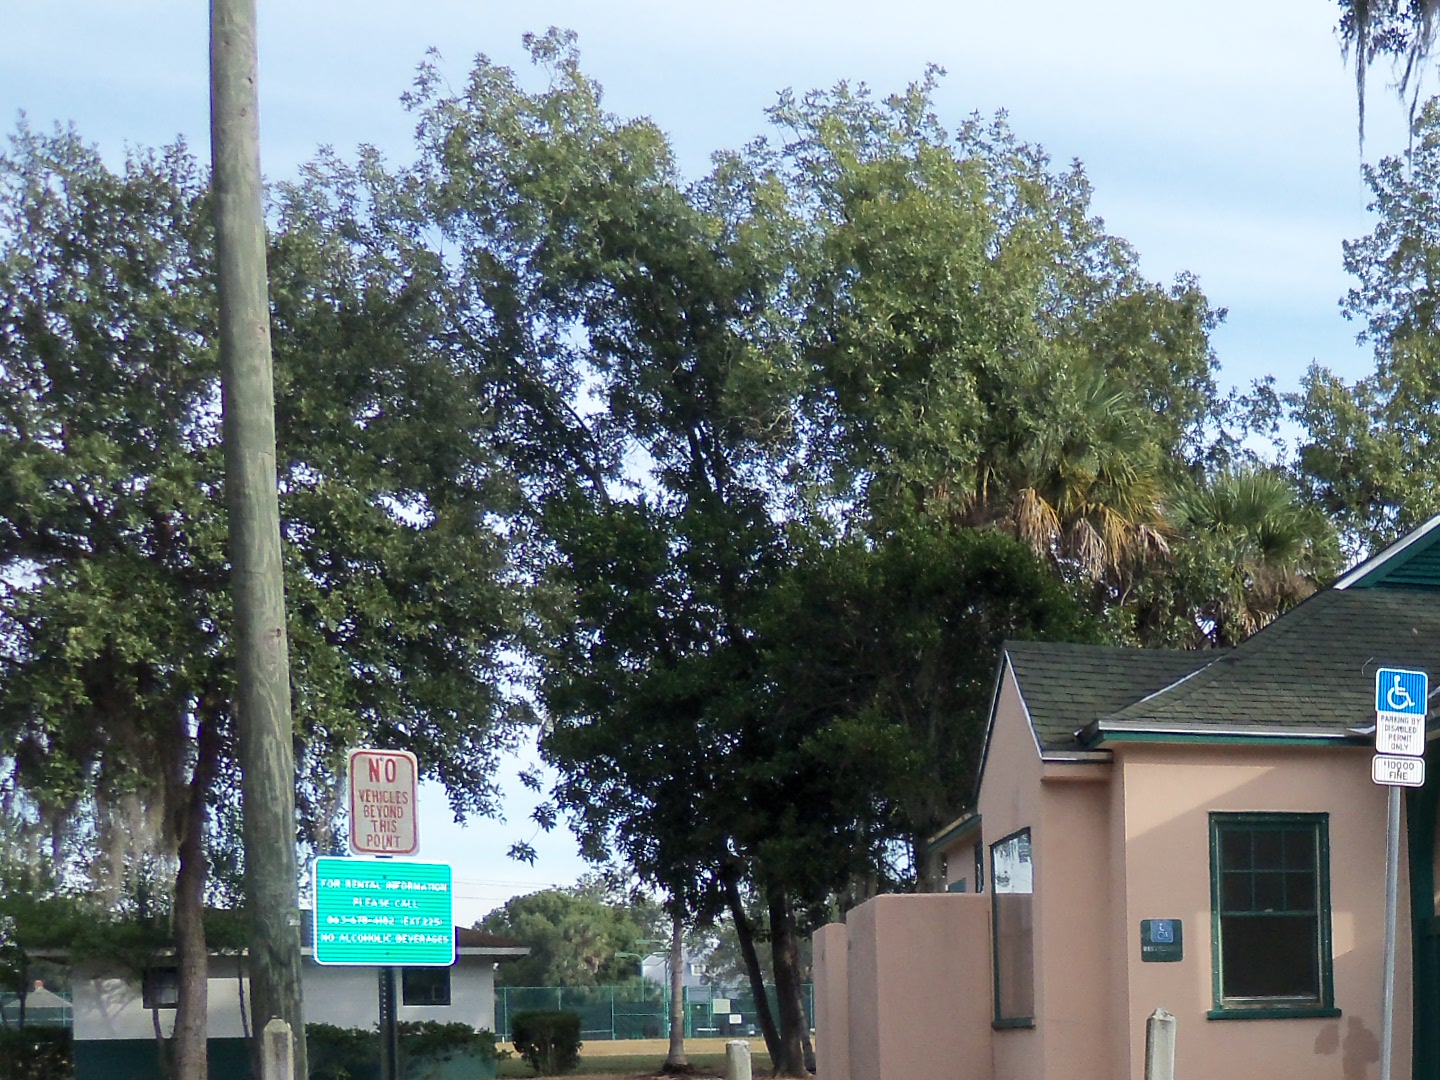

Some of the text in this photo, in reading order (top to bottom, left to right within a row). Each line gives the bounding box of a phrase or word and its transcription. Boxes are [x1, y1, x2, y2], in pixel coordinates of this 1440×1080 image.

[1381, 715, 1421, 726] PARKING BY
[1388, 734, 1412, 743] PERMIT
[1391, 743, 1408, 751] ONLY
[369, 758, 397, 783] NO
[1389, 771, 1408, 781] FINE
[358, 790, 408, 804] VEHICLES
[363, 804, 404, 819] BEYOND
[370, 820, 397, 833] THIS
[366, 834, 401, 848] POINT
[320, 879, 449, 892] FOR RENTAL INFORMATION
[352, 897, 419, 909] PLEASE CALL
[321, 933, 450, 944] NO ALCOHOLIC BEVERAGES
